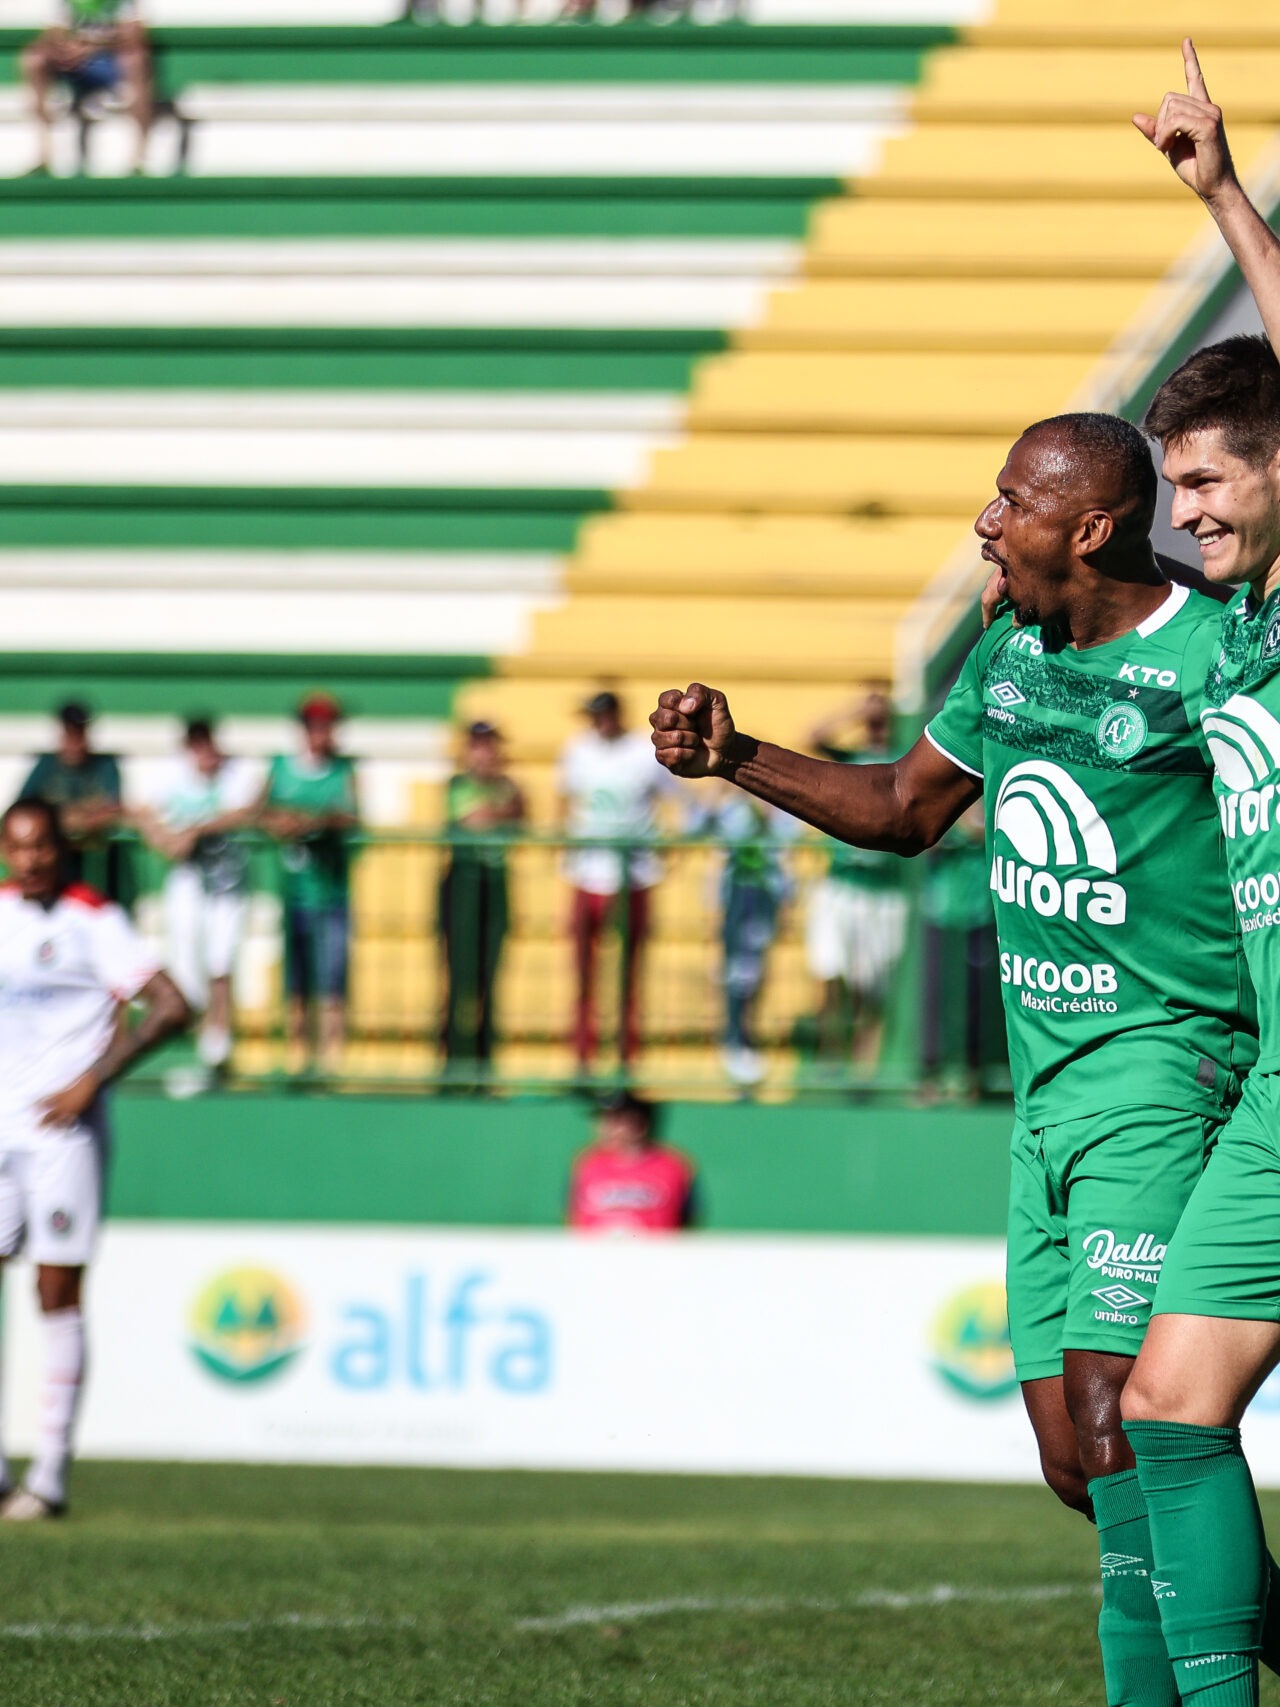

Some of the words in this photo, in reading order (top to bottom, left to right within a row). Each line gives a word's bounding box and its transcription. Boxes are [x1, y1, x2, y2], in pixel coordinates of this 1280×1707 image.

[1117, 663, 1177, 687] KTO
[987, 706, 1016, 724] umbro
[1000, 951, 1118, 995] SICOOB
[1021, 990, 1118, 1013] MaxiCrédito
[1101, 1266, 1133, 1280] PURO
[1135, 1271, 1159, 1285] MAL
[1094, 1310, 1138, 1325] umbro
[330, 1271, 556, 1392] alfa
[1184, 1653, 1236, 1669] umbr
